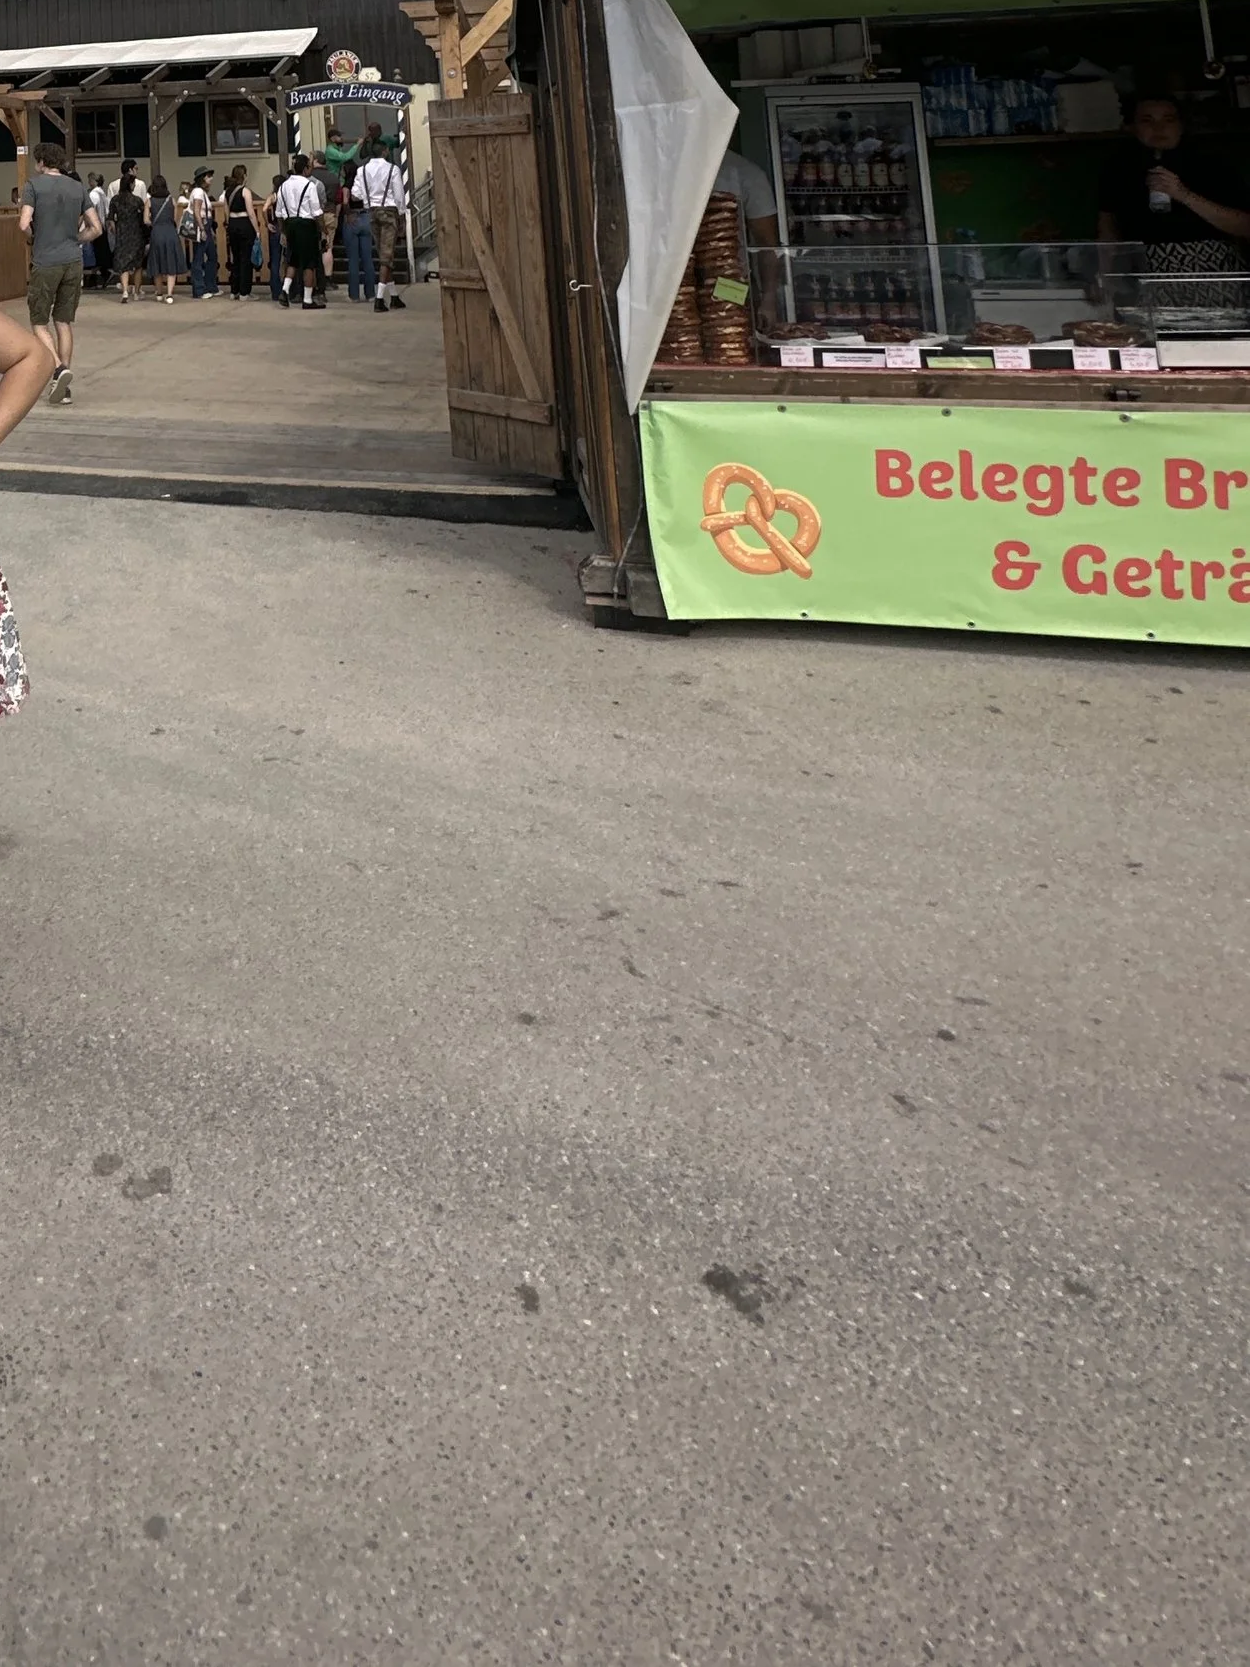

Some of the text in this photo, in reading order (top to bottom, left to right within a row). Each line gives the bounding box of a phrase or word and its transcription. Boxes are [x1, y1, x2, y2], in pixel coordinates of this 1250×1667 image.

[289, 83, 406, 106] Brauerei Eingang
[874, 449, 1249, 517] Belegte Br
[991, 540, 1042, 591] &
